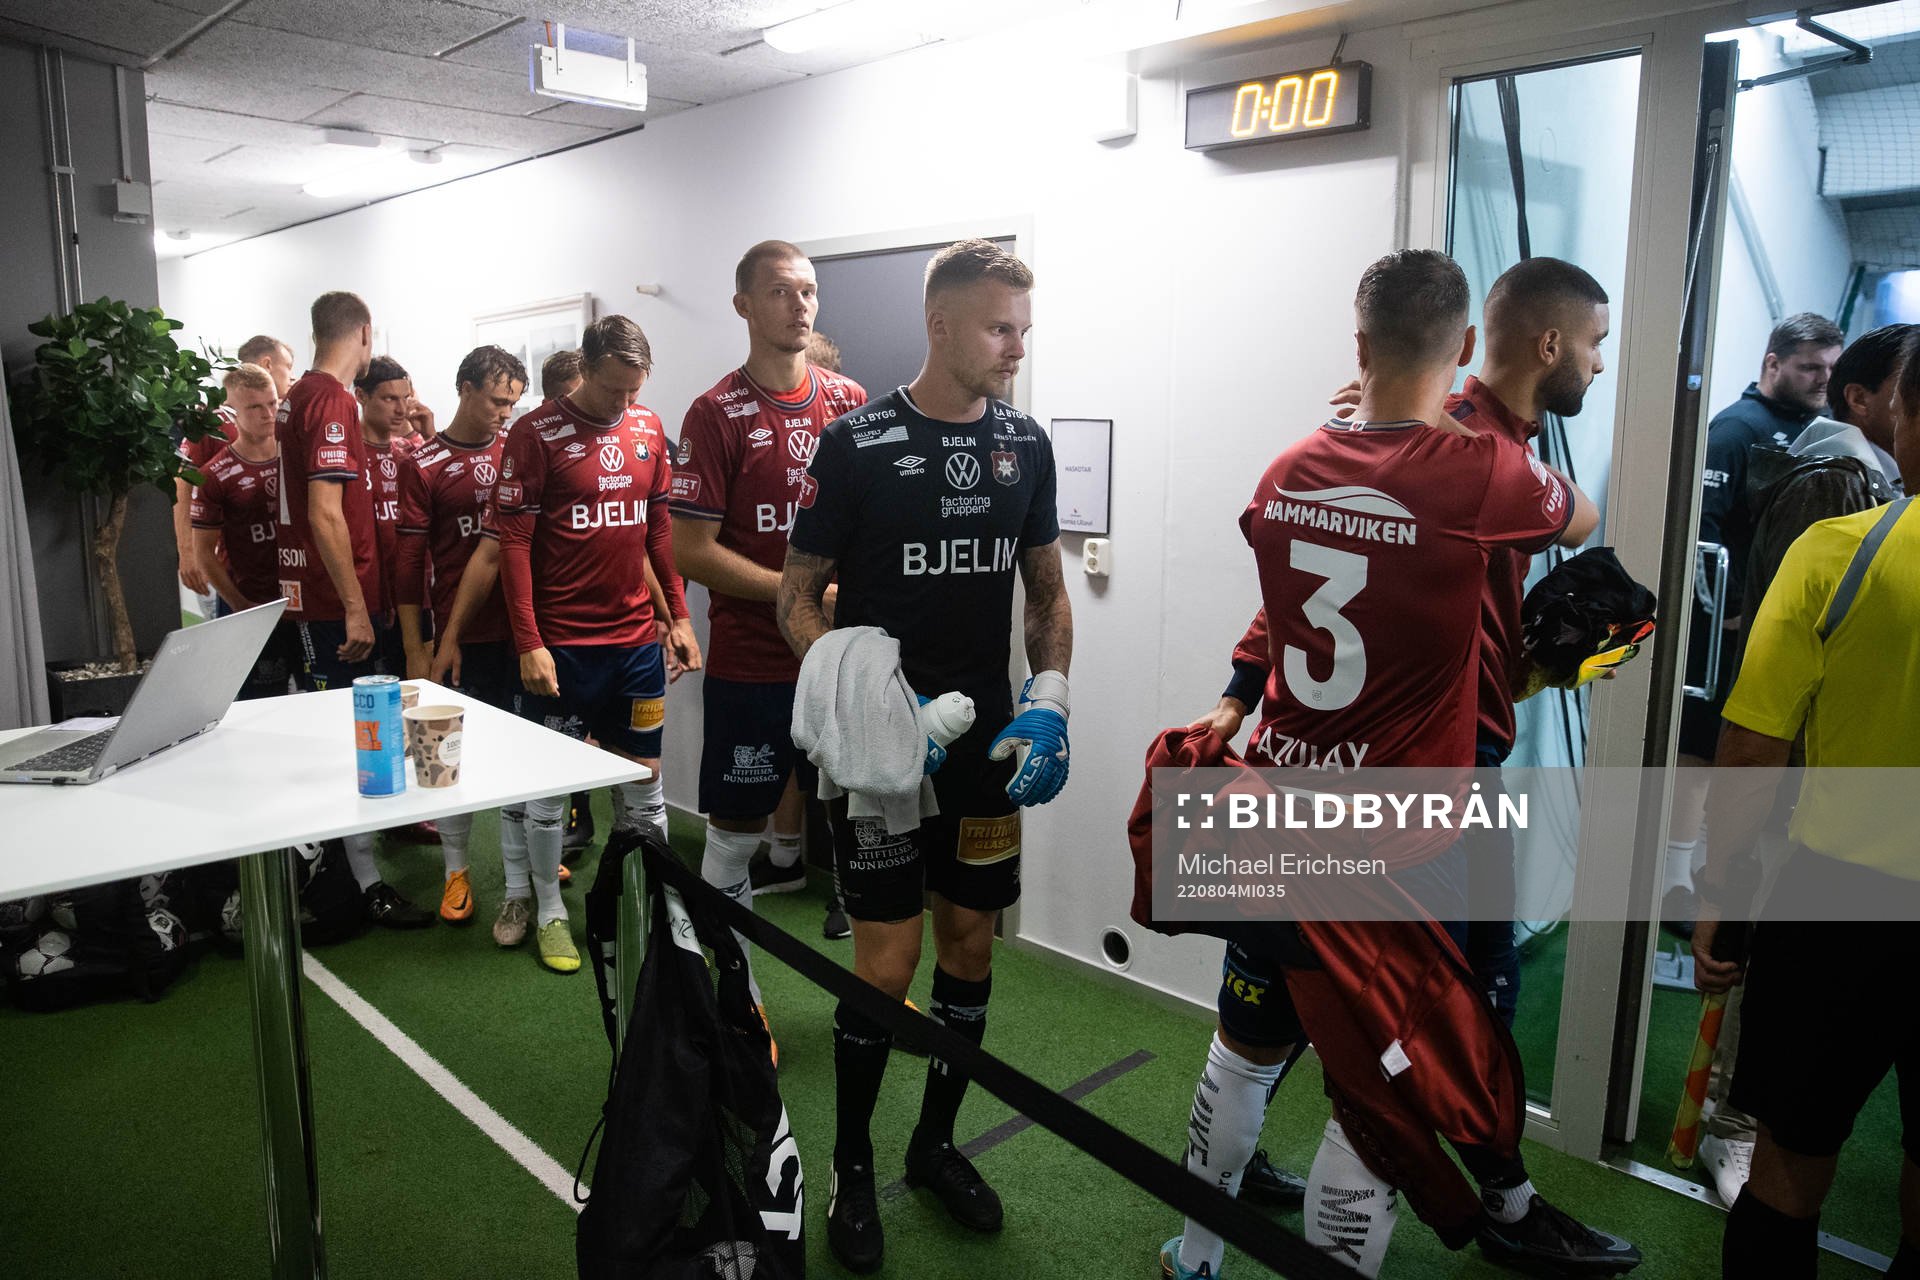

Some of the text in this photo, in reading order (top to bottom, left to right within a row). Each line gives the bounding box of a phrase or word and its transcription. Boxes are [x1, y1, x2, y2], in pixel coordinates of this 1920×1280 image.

[1230, 69, 1339, 138] 0:00
[867, 409, 896, 422] BYGG
[785, 418, 812, 428] BJELIN
[596, 436, 620, 445] BJELIN
[752, 440, 773, 449] umbro
[942, 437, 976, 447] BJELIN
[599, 474, 633, 485] factoring
[900, 468, 925, 477] umbro
[1705, 469, 1730, 482] BET
[941, 495, 991, 507] factoring
[572, 500, 648, 529] BJELIN
[941, 503, 989, 518] gruppen.
[1263, 500, 1417, 545] HAMMARVIKEN
[904, 537, 1018, 576] BJELIN
[1284, 539, 1369, 712] 3
[1256, 726, 1370, 775] AZULAY
[857, 843, 914, 861] STIFTELSEN
[1318, 1184, 1377, 1265] NIK
